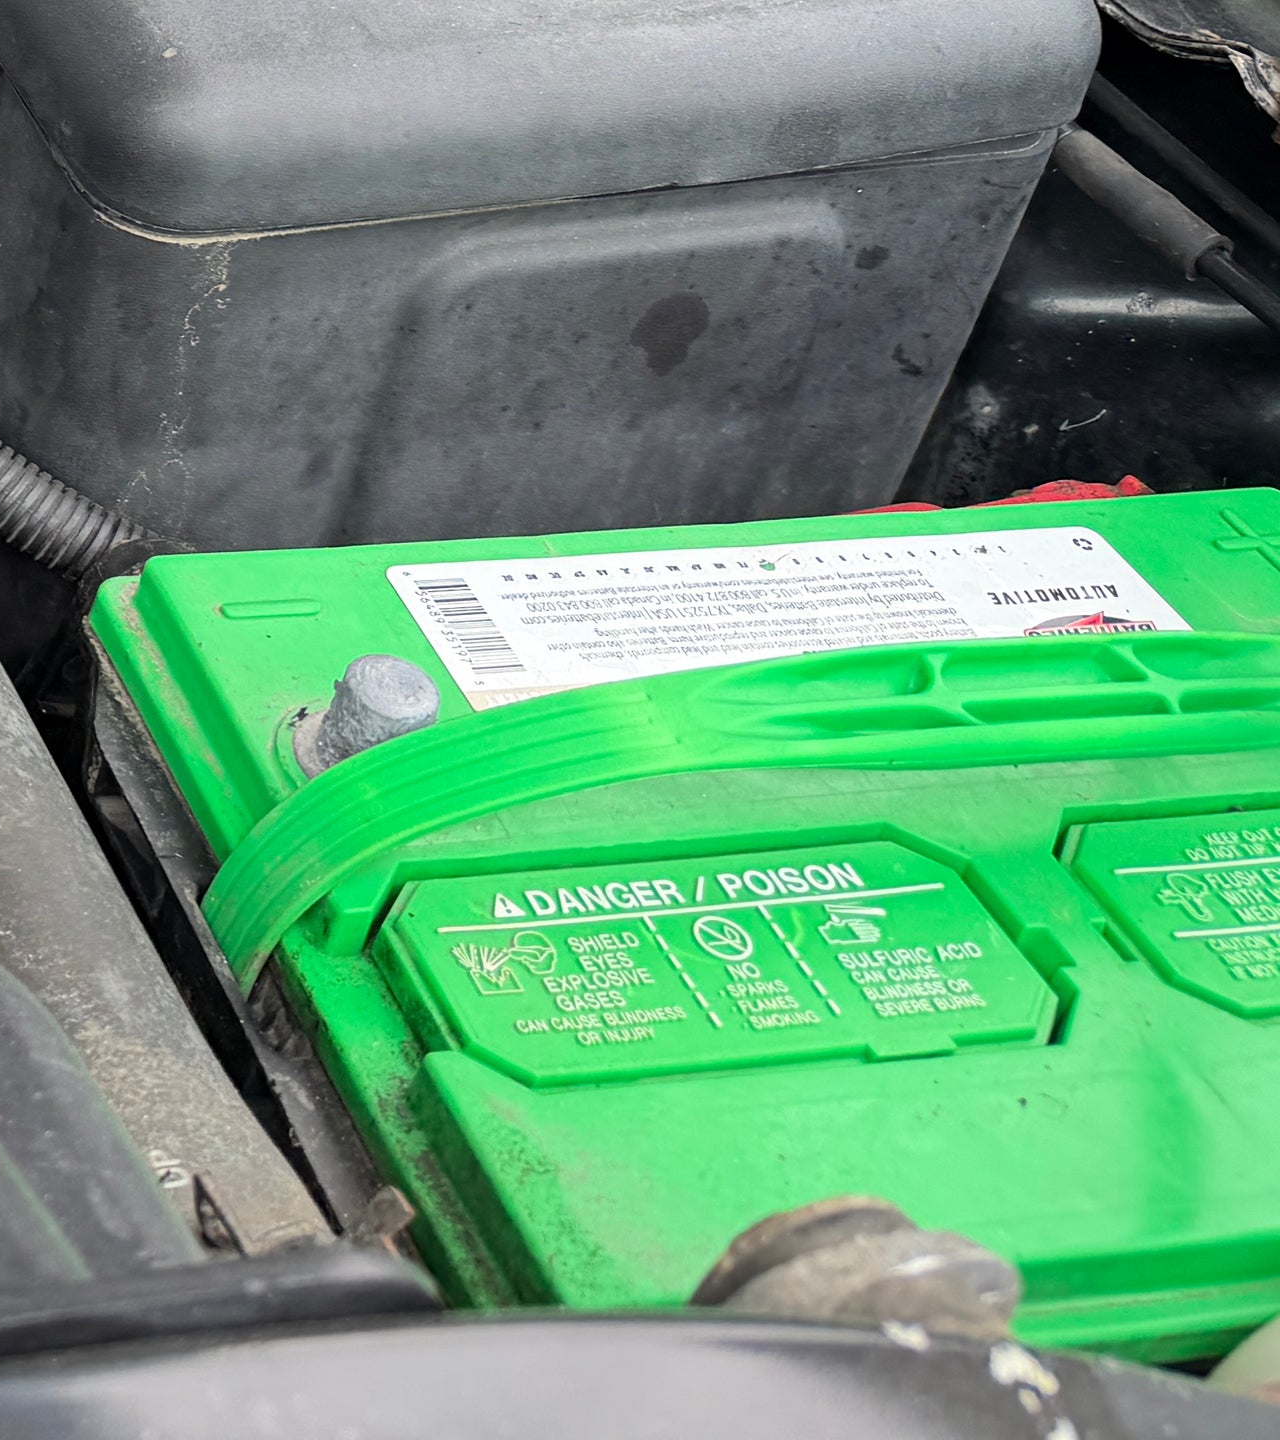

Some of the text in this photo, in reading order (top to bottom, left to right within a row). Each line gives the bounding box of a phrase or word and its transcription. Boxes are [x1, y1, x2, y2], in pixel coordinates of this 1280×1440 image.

[747, 588, 770, 597] call
[847, 581, 883, 591] under
[877, 577, 920, 589] replace
[600, 597, 622, 607] call
[619, 595, 662, 606] Canada
[761, 596, 818, 611] Batteries,
[813, 596, 870, 608] Interstate
[881, 591, 945, 603] Distributed
[986, 583, 1120, 606] AUTOMOTIVE
[648, 608, 677, 619] USA
[675, 605, 716, 617] 75251
[725, 599, 767, 613] Dallas,
[519, 609, 647, 627] interstatebatteries.com
[1203, 828, 1274, 846] KEEP OUT
[1185, 847, 1210, 861] DO
[1209, 845, 1241, 859] NOT
[524, 862, 865, 917] DANGER / POISON
[1204, 869, 1267, 890] FLUSH
[1219, 887, 1272, 905] WITH
[567, 931, 640, 954] SHIELD
[1208, 935, 1271, 952] CAUTION
[578, 951, 635, 973] EYES
[837, 941, 984, 971] SULFURIC ACID
[542, 967, 656, 994] EXPLOSIVE
[726, 961, 762, 982] NO
[850, 964, 942, 986] CAN CAUSE
[726, 978, 790, 999] SPARKS
[861, 978, 974, 1002] BLINDNESS OR
[555, 990, 627, 1012] GASES
[737, 994, 801, 1016] FLAMES
[873, 994, 988, 1019] SEVERE BURNS
[515, 1005, 688, 1035] CAN CAUSE BLINDNESS
[748, 1010, 822, 1031] SMOKING
[577, 1026, 656, 1047] OR INJURY
